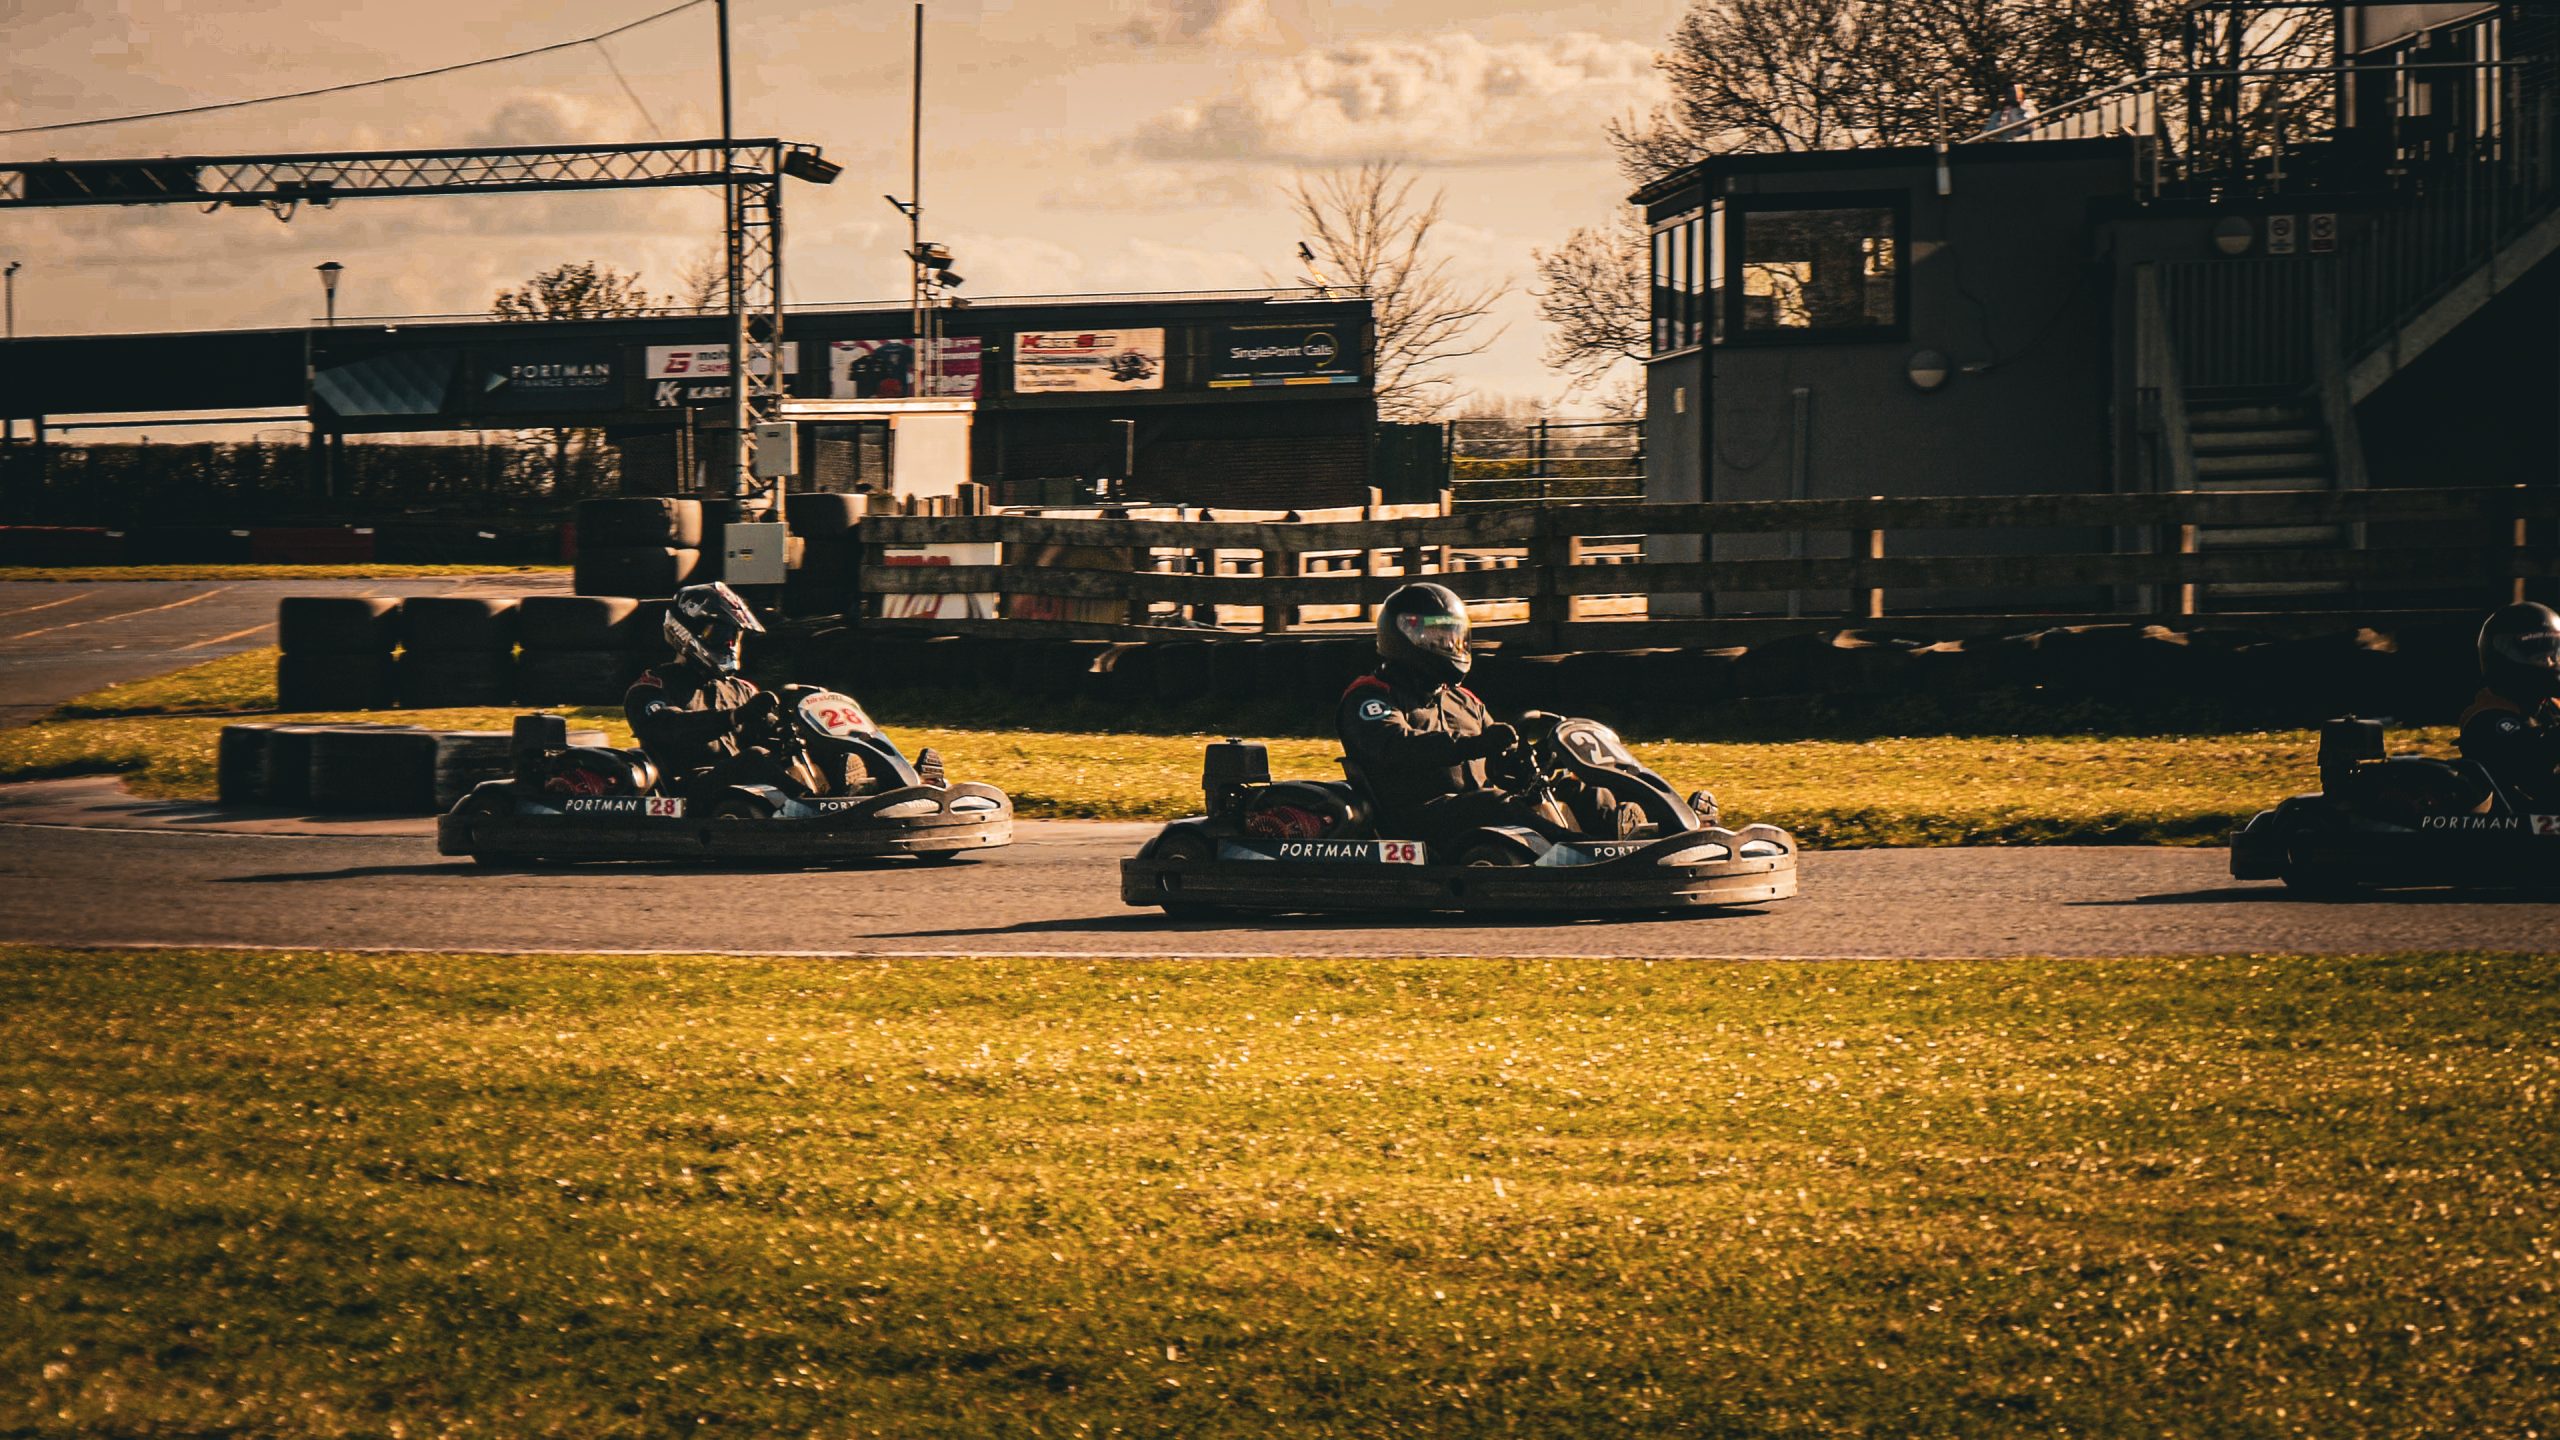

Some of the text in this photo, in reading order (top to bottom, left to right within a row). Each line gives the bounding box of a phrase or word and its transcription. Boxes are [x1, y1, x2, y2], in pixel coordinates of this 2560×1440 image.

[511, 363, 610, 379] PORTMAN
[819, 708, 863, 728] 28
[565, 798, 637, 811] PORTMAN
[650, 799, 675, 815] 28
[2421, 815, 2519, 829] PORTMAN
[1280, 842, 1369, 857] PORTMAN
[1384, 843, 1416, 861] 26
